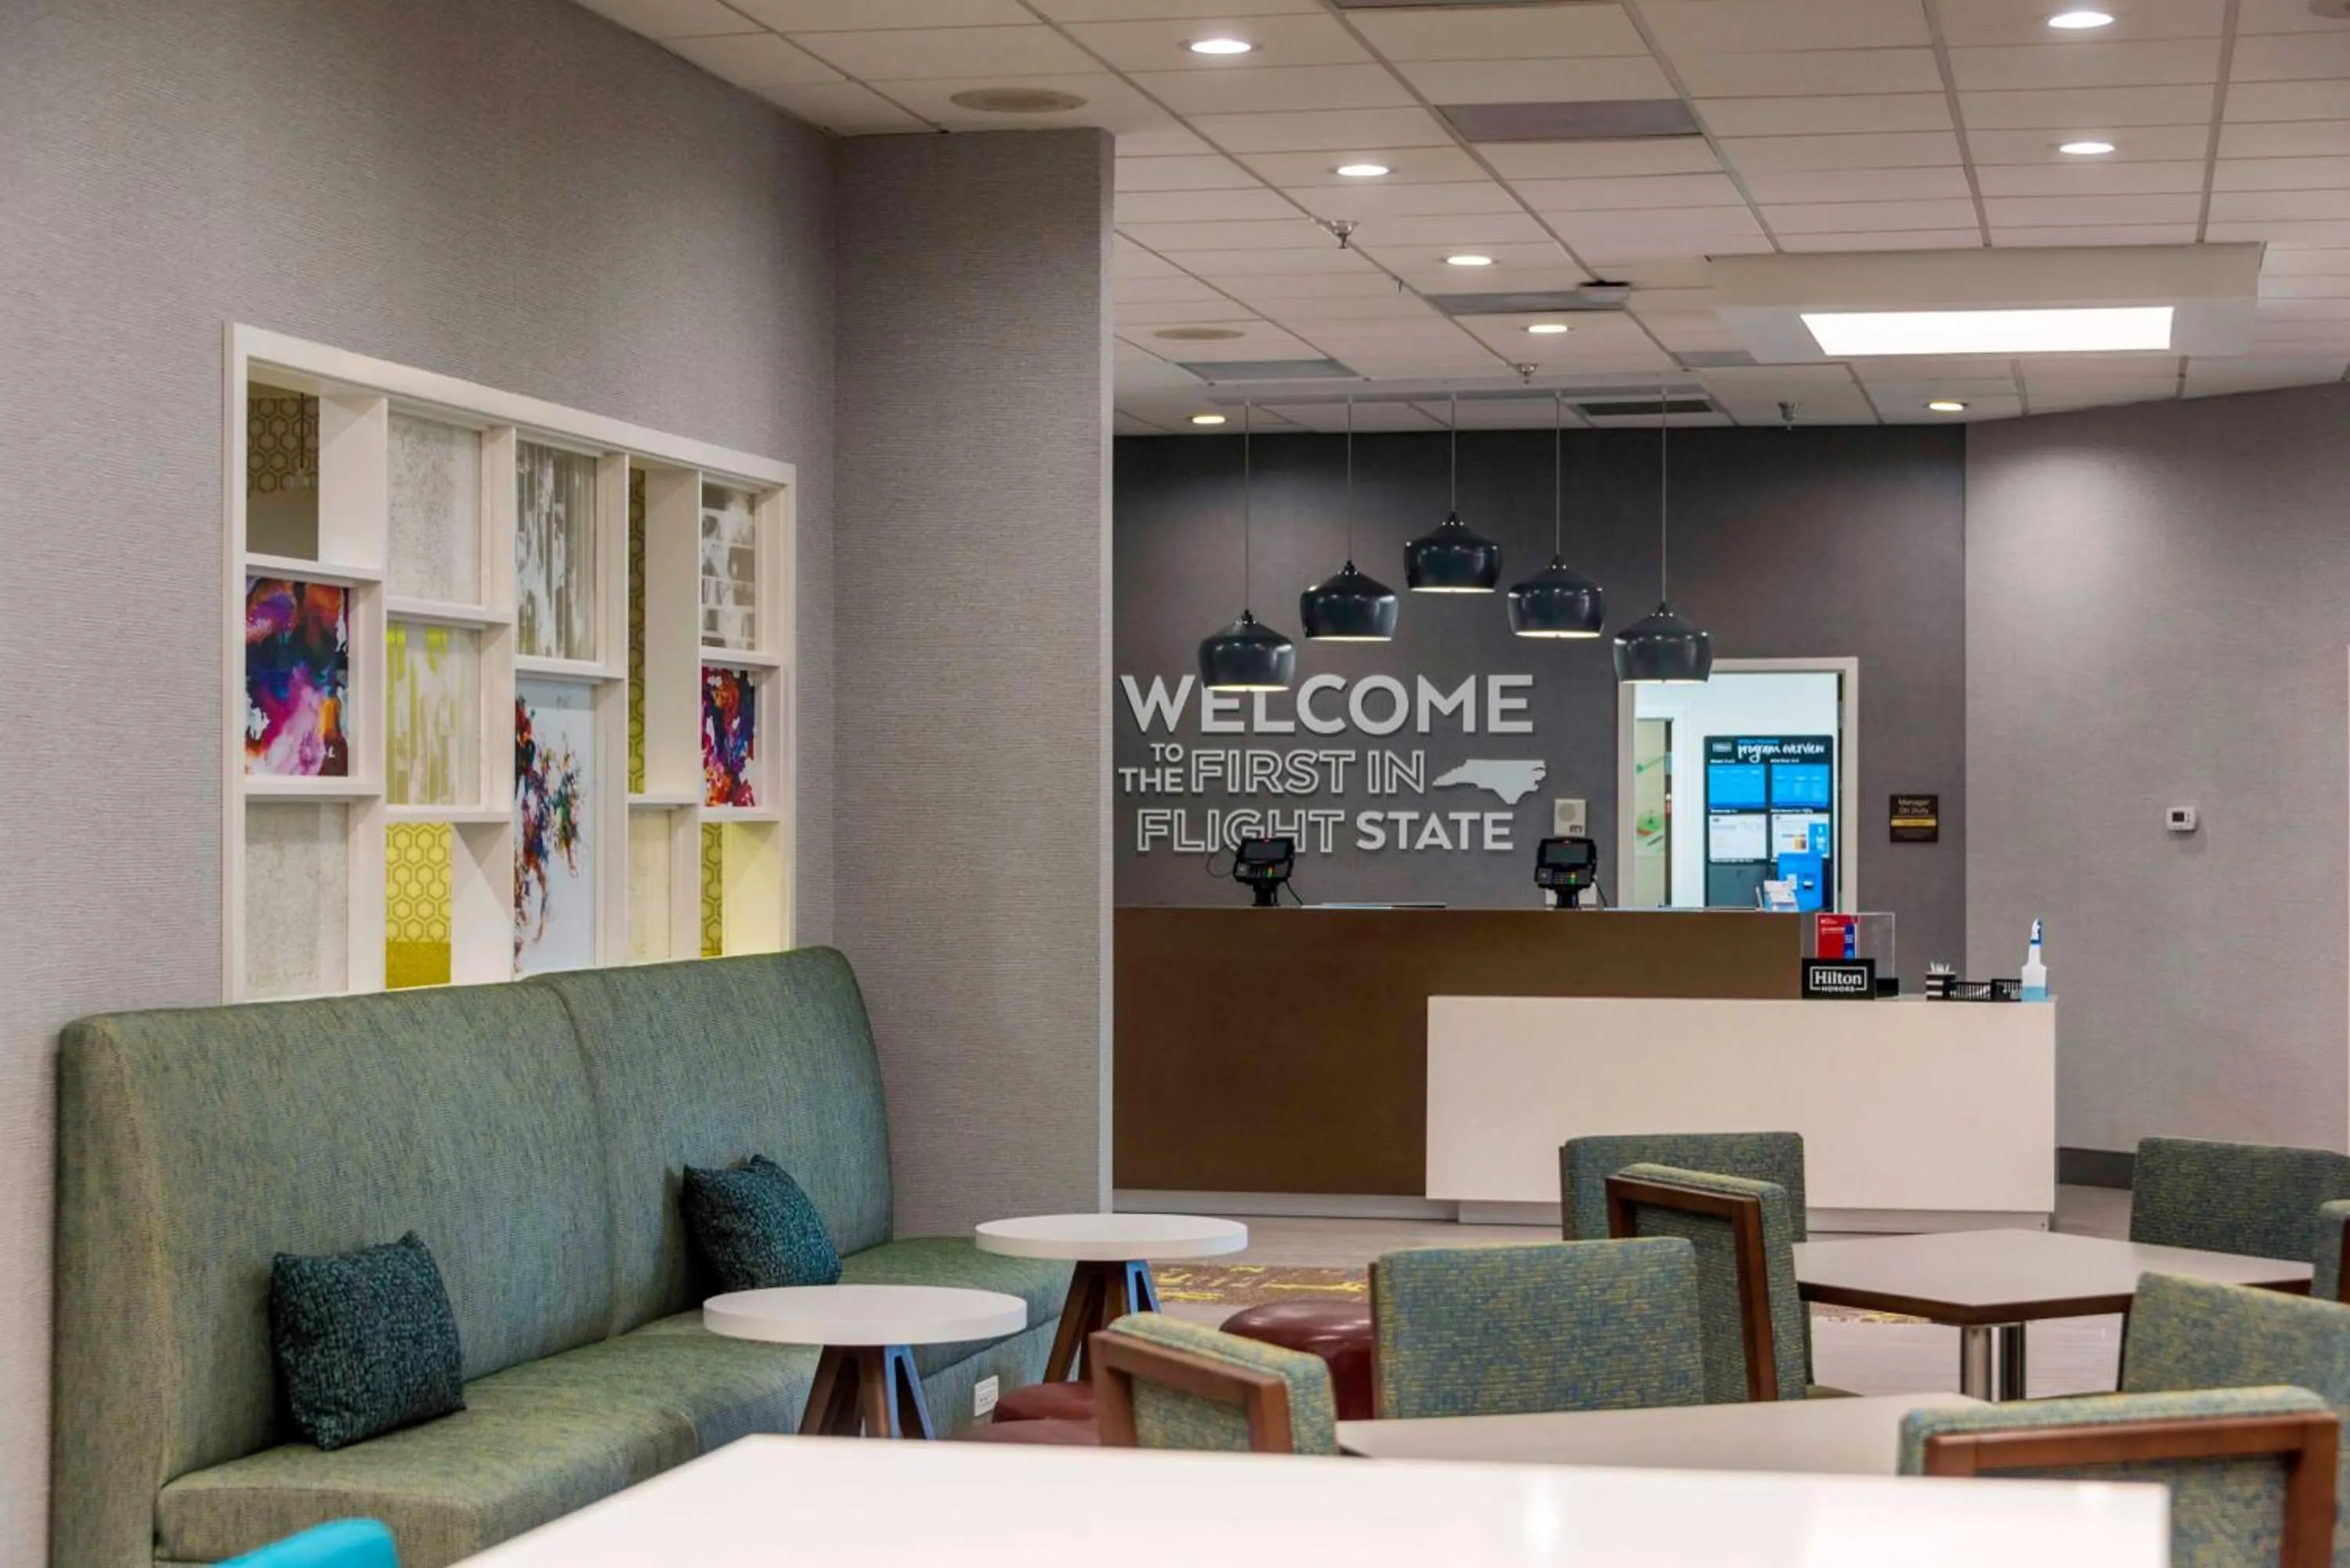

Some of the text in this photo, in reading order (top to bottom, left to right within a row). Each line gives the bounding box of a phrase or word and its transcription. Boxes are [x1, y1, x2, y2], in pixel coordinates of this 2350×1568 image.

[1120, 674, 1533, 735] WELCOME
[1150, 743, 1184, 762] TO
[1737, 742, 1781, 764] program
[1119, 750, 1425, 794] THE FIRST IN
[1137, 808, 1514, 852] FLIGHT STATE
[1815, 970, 1862, 985] Hilton
